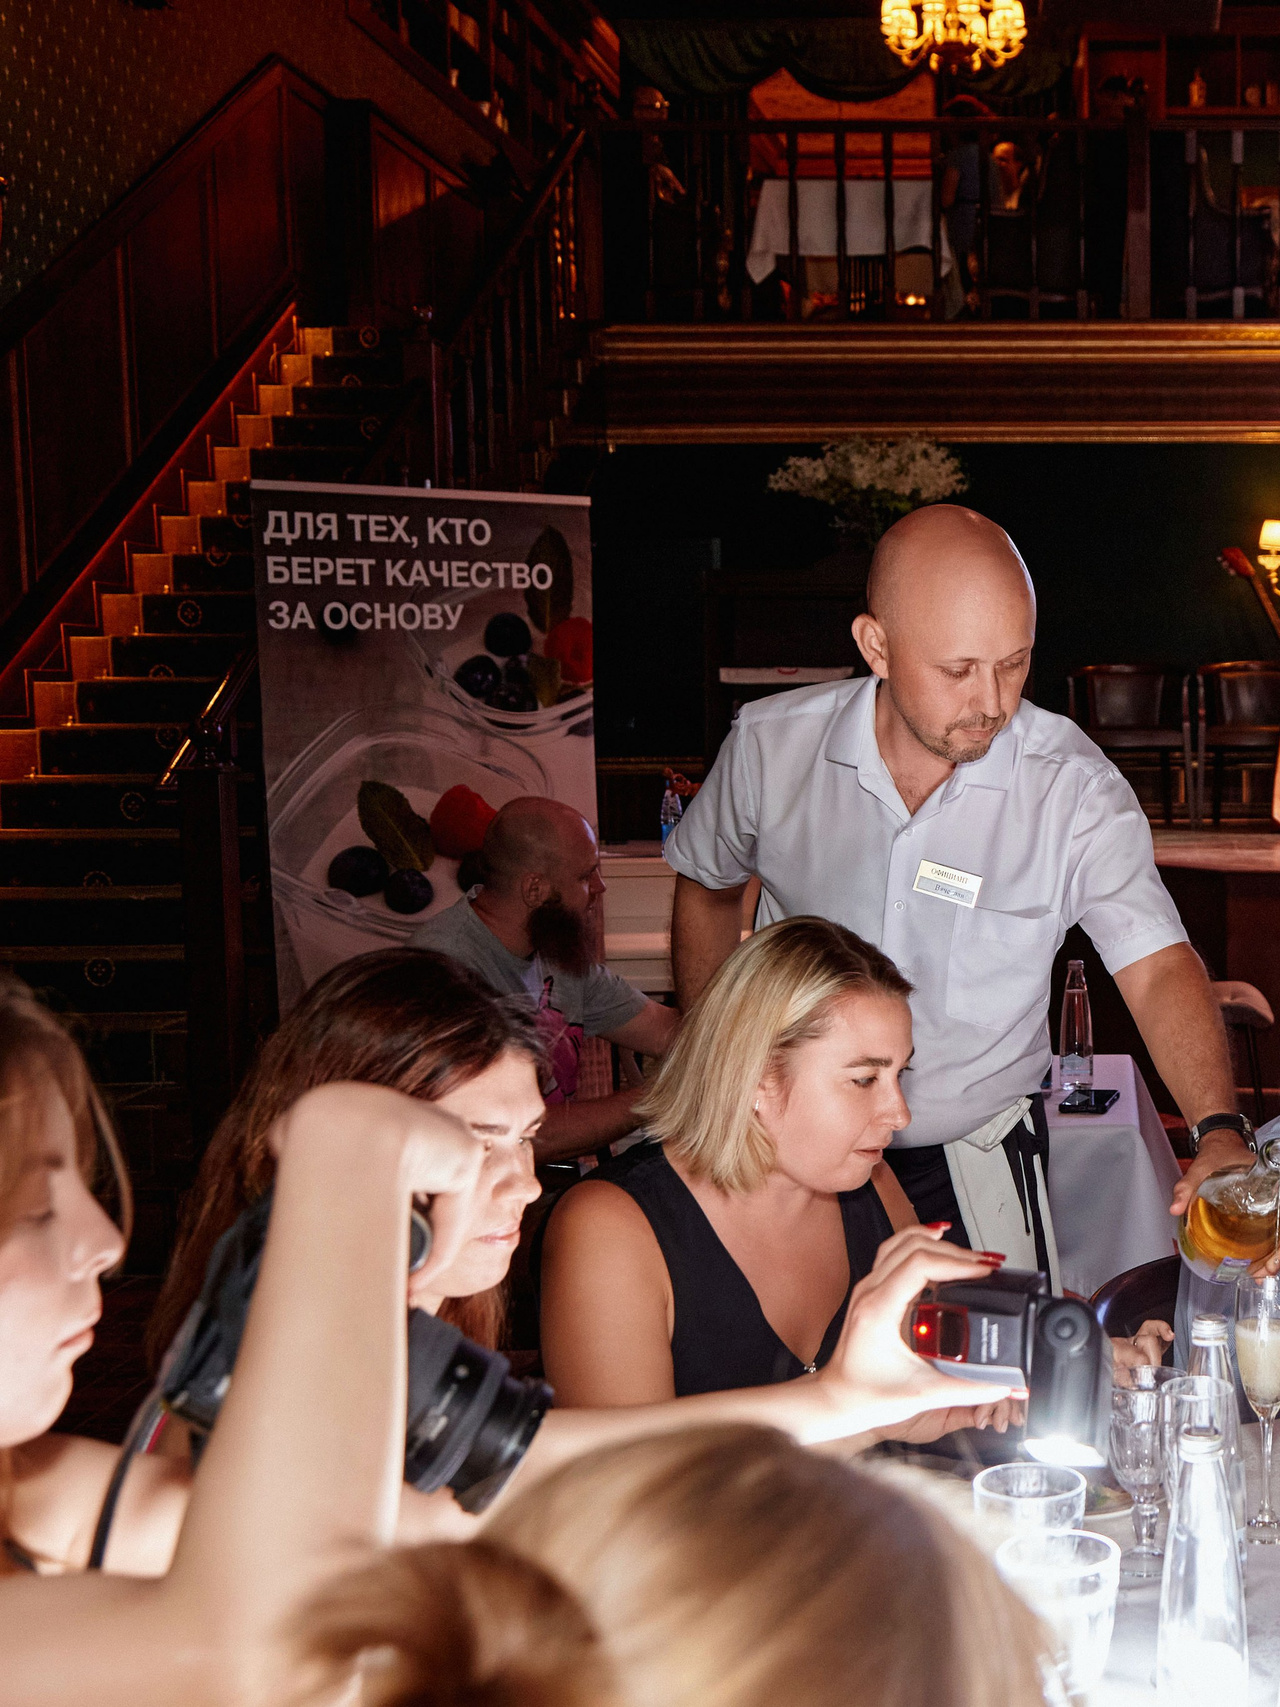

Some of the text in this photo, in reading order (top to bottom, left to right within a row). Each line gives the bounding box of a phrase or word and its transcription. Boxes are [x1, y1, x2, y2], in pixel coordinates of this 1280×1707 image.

[263, 511, 492, 549] ДЛЯ ТЕХ, КТО
[266, 556, 553, 590] БЕРЕТ КАЧЕСТВО
[268, 602, 464, 631] ЗА ОСНОВУ
